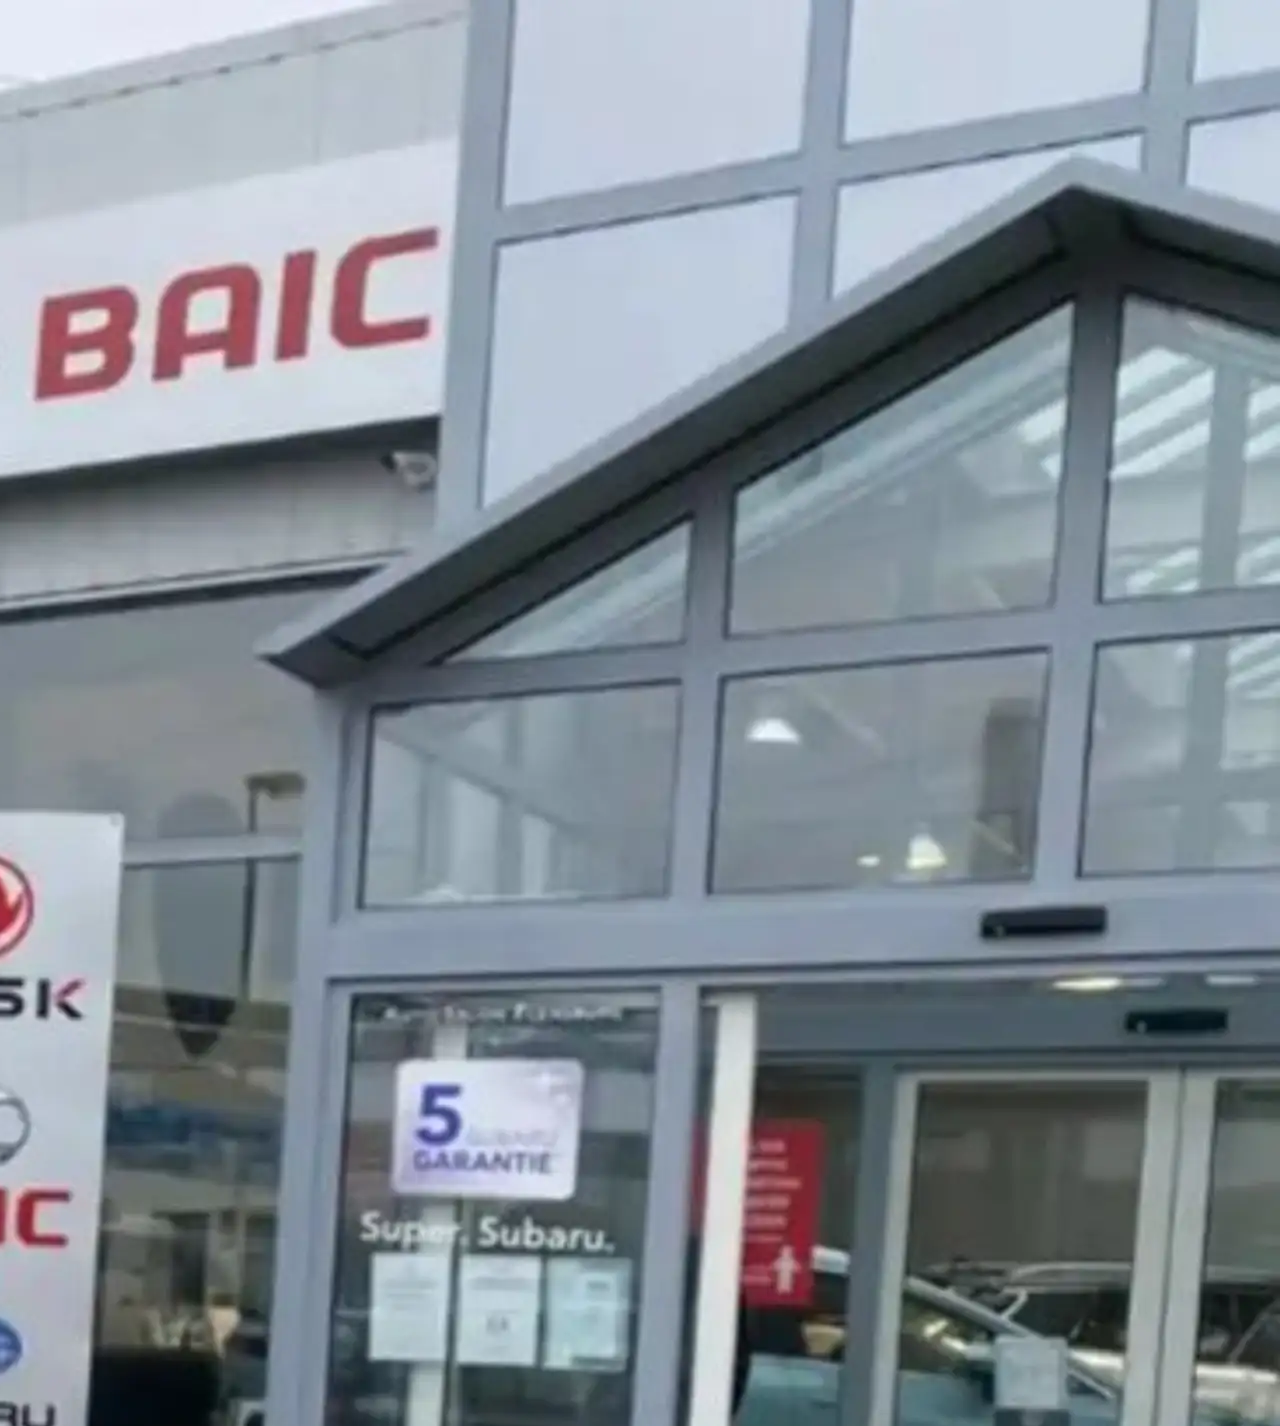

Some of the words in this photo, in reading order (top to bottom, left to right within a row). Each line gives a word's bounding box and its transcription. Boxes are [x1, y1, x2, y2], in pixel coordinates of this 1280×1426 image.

[34, 227, 438, 402] BAIC
[416, 1083, 463, 1146] 5
[412, 1150, 553, 1175] GARANTIE
